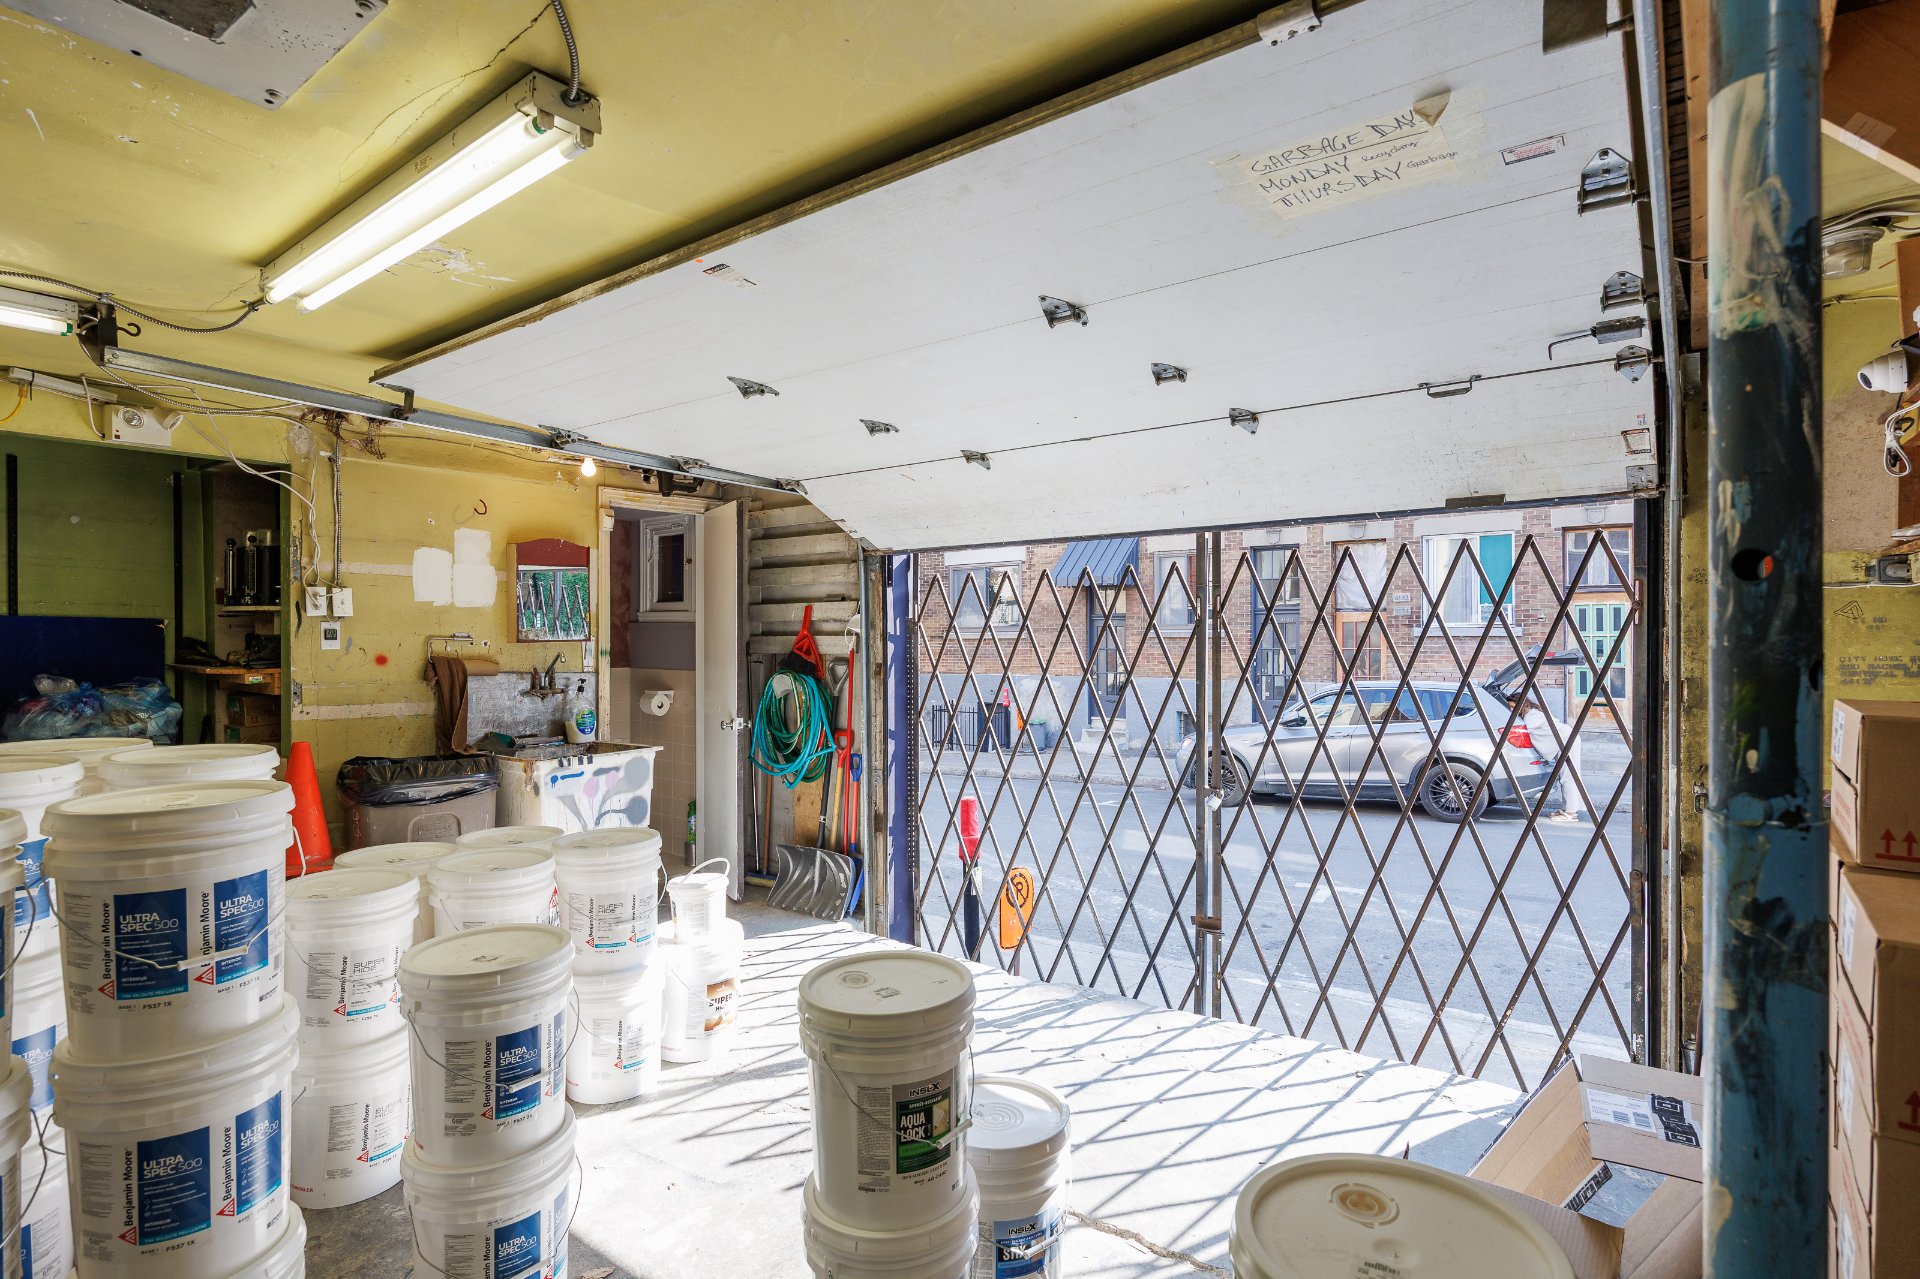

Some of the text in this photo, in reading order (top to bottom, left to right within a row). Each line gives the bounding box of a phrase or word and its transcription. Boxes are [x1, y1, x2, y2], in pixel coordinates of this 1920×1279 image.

[1251, 131, 1364, 173] GARBAGE
[1259, 156, 1351, 193] MONDAY
[1273, 162, 1401, 208] THURSDAY
[200, 891, 210, 925] Moore
[220, 894, 252, 910] ULTRA
[220, 897, 265, 918] SPEC 500
[598, 902, 624, 910] SUPER
[119, 912, 160, 924] ULTRA
[119, 918, 179, 933] SPEC 500
[353, 957, 385, 969] SUPER
[353, 966, 376, 974] HIDE
[338, 976, 347, 1004] Benjamin
[484, 1042, 492, 1072] Moore
[500, 1046, 528, 1059] ULTRA
[500, 1049, 538, 1067] SPEC 500
[909, 1080, 941, 1097] INSL-X
[900, 1112, 926, 1128] AQUA
[240, 1119, 270, 1141] ULTRA
[361, 1121, 370, 1152] Benjamin
[901, 1126, 926, 1142] LOCK
[240, 1130, 266, 1150] SPEC
[143, 1154, 184, 1170] ULTRA
[143, 1157, 203, 1179] SPEC 500
[222, 1126, 234, 1201] Benjamin Moore
[124, 1150, 136, 1227] Benjamin Moore
[1008, 1222, 1037, 1235] INSL-X
[498, 1235, 526, 1251] ULTRA
[498, 1244, 521, 1258] SPEC
